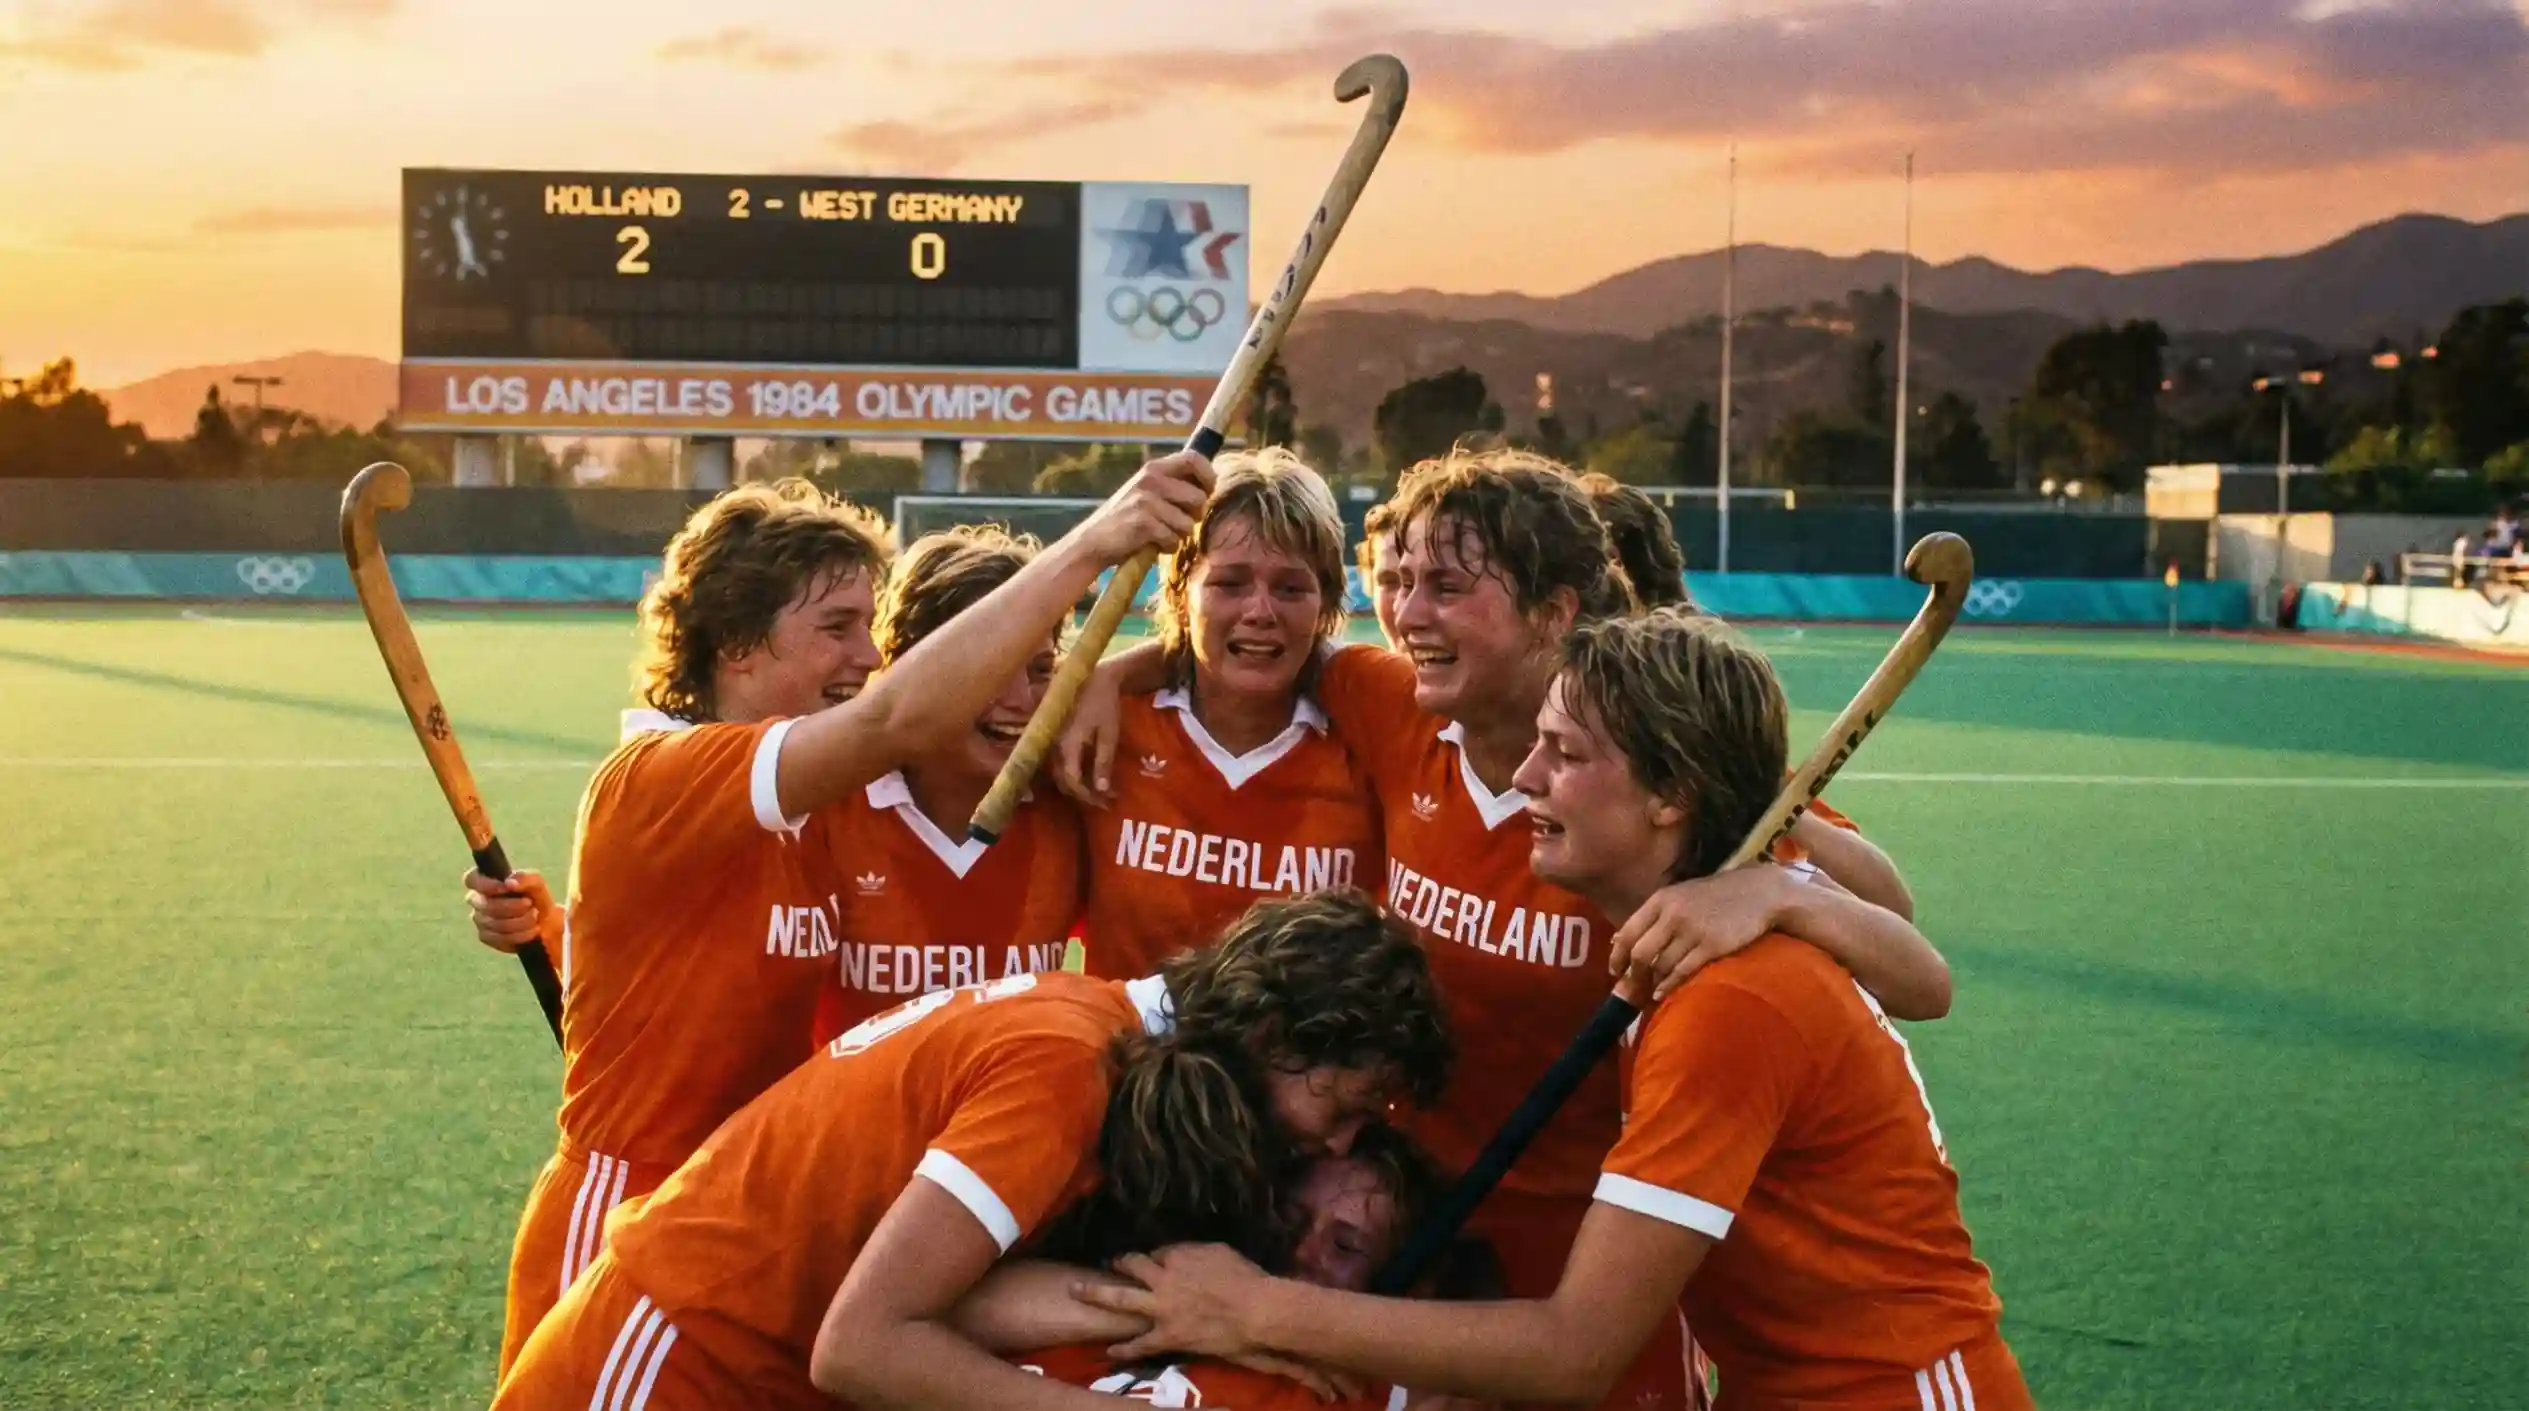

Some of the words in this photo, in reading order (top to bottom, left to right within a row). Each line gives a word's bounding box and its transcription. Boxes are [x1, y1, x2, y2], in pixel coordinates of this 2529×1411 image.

[545, 185, 681, 217] HOLLAND
[728, 189, 750, 218] 2
[800, 190, 877, 220] WEST
[888, 193, 1023, 223] GERMANY
[616, 226, 650, 273] 2
[911, 232, 945, 279] 0
[446, 376, 528, 414] LOS
[541, 378, 734, 417] ANGELES
[747, 380, 842, 418] 1984
[856, 381, 1032, 421] OLYMPIC
[1045, 387, 1193, 425] GAMES
[1115, 818, 1355, 895] NEDERLAND
[1388, 857, 1590, 968] NEDERLAND
